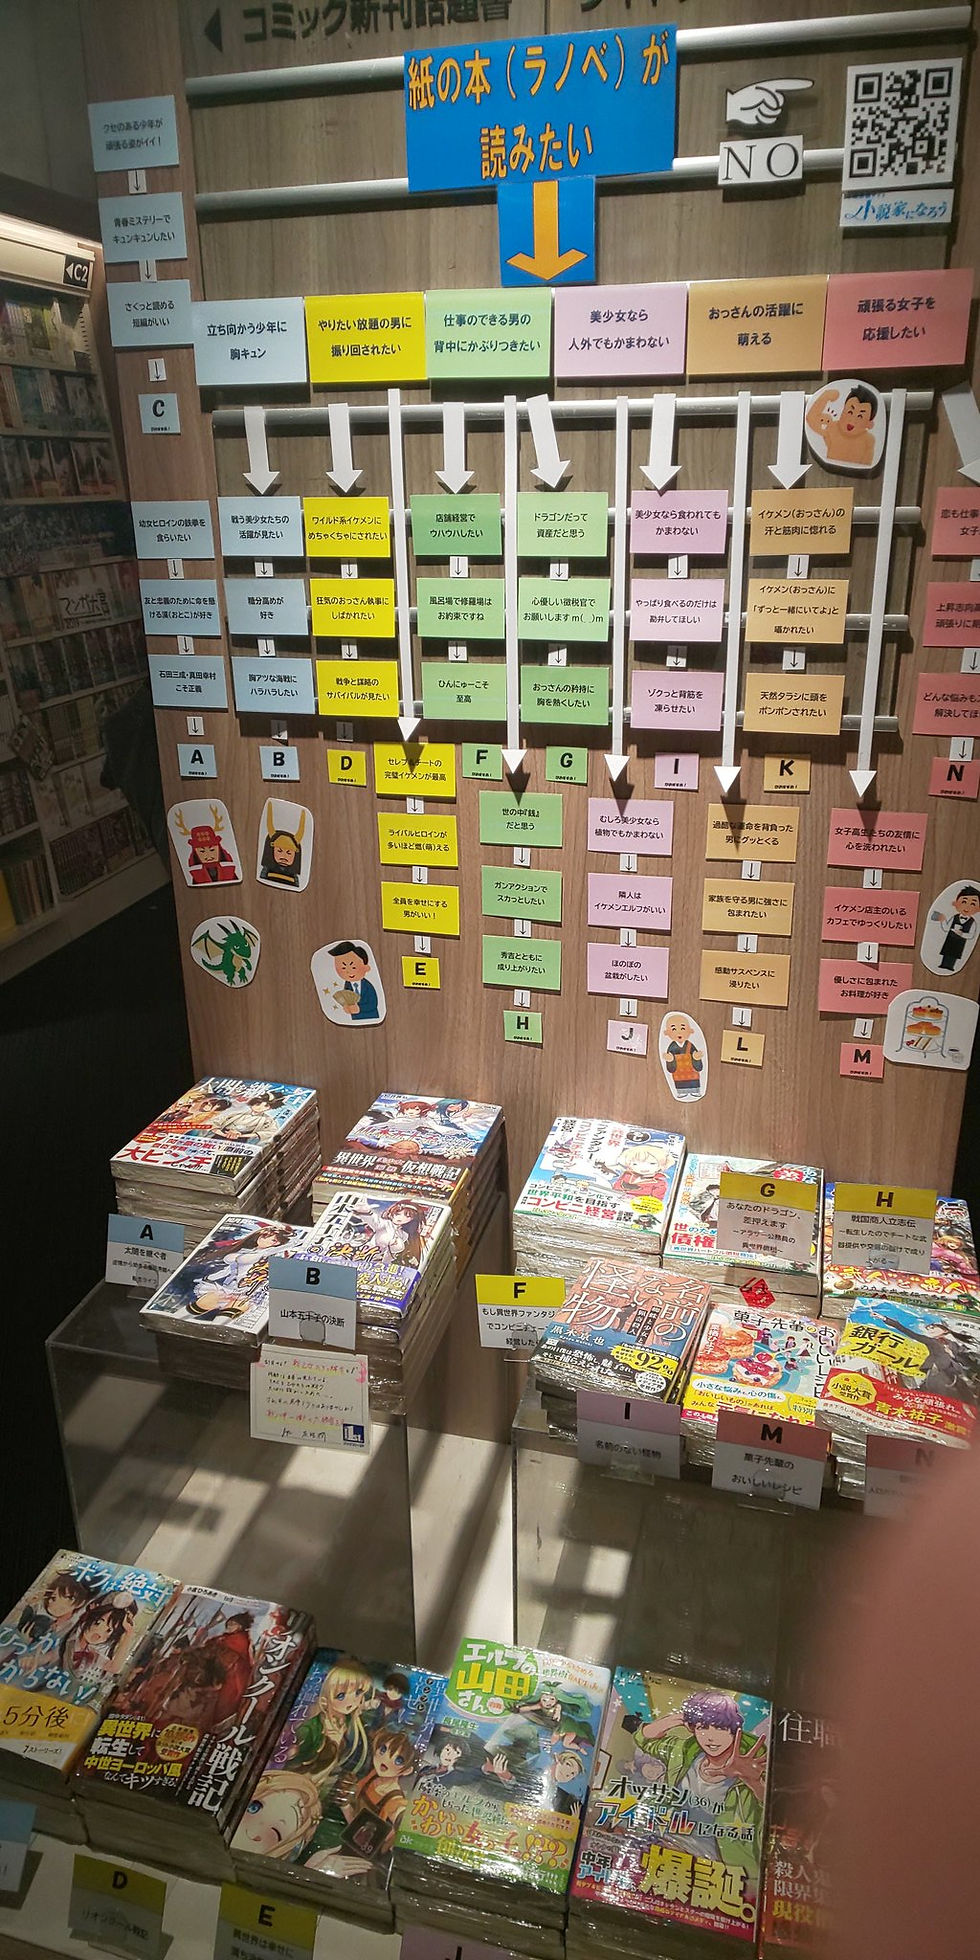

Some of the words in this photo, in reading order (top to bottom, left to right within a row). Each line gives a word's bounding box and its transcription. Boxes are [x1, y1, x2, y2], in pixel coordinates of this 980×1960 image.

[480, 123, 594, 180] 読みたい
[723, 143, 799, 181] NO
[844, 199, 947, 221] 小説家になろう
[114, 215, 171, 227] 青春ミステリーで
[113, 234, 175, 244] キュンキュンしたい
[73, 263, 89, 280] C2
[125, 301, 175, 312] さくっと読める
[709, 302, 803, 320] おっさんの活躍に
[857, 296, 935, 313] 頑張る女子を
[443, 312, 530, 327] 仕事のできる男の
[589, 309, 649, 323] 美少女なら
[207, 320, 287, 337] 立ち向かう少年に
[318, 316, 411, 333] やりたい放題の男に
[737, 331, 772, 345] 萌える
[863, 325, 925, 341] 応援したい
[331, 342, 401, 357] 振り回されたい
[434, 338, 541, 354] 背中にかぶりつきたい
[568, 335, 669, 351] 人外でもかまわない
[230, 346, 266, 360] 胸キュン
[152, 400, 165, 417] C
[231, 515, 289, 524] 戦う美少女たちの
[312, 516, 381, 525] ワイルド系イケメンに
[436, 513, 475, 522] 店舗経営で
[534, 512, 588, 522] ドラゴンだって
[635, 510, 721, 520] 美少女なら食われても
[239, 530, 283, 539] 活躍が見たい
[308, 531, 388, 540] めちゃくちゃにされたい
[430, 528, 483, 538] ウハウハしたい
[536, 528, 584, 538] 資産だと思う
[656, 526, 698, 535] かまわない
[764, 525, 836, 535] 汗と筋肉に惚れる
[157, 533, 191, 542] 食らいたい
[317, 596, 389, 606] 狂気のおっさん執事に
[430, 596, 492, 606] 風呂場で修羅場は
[636, 599, 717, 609] やっぱり食べるのだけは
[260, 611, 274, 619] 好き
[332, 611, 374, 620] しばかれたい
[438, 612, 484, 621] お約束ですね
[650, 615, 700, 624] 勘弁してほしい
[249, 674, 297, 683] 胸アツな海戦に
[336, 678, 378, 686] 戦争と謀略の
[438, 680, 488, 689] ひんにゅーこそ
[176, 684, 202, 693] こそ正義
[251, 688, 298, 697] ハラハラしたい
[532, 683, 594, 693] おっさんの矜持に
[648, 689, 703, 699] ゾクっと背筋を
[326, 691, 390, 701] サバイバルが見たい
[456, 694, 472, 703] 至高
[760, 691, 827, 702] 天然タラシに頭を
[537, 698, 590, 708] 胸を熱くしたい
[655, 704, 696, 713] 凍らせたい
[191, 750, 203, 764] A
[273, 752, 284, 766] B
[341, 756, 352, 770] D
[476, 750, 488, 764] F
[560, 753, 573, 768] G
[674, 759, 679, 774] I
[779, 760, 794, 776] K
[947, 764, 964, 781] N
[384, 771, 446, 781] 完璧イケメンが最高
[506, 821, 535, 831] だと思う
[600, 815, 660, 826] むしろ美少女なら
[388, 828, 447, 839] ライバルヒロインが
[595, 828, 664, 839] 植物でもかまわない
[834, 827, 920, 839] 女子高生たちの友情に
[725, 835, 779, 846] 男にグッとくる
[845, 841, 905, 853] 心を洗われたい
[494, 881, 548, 892] ガンアクションで
[497, 894, 545, 906] スカっとしたい
[618, 890, 641, 899] 隣人は
[708, 894, 787, 907] 家族を守る男に強さに
[393, 897, 448, 908] 全員を幸せにする
[594, 903, 665, 914] イケメンエルフがいい
[727, 909, 767, 918] 包まれたい
[834, 904, 906, 915] イケメン店主のいる
[827, 917, 912, 930] カフェでゆっくりしたい
[501, 951, 542, 962] 秀吉とともに
[416, 962, 426, 976] E
[497, 964, 545, 974] 成り上がりたい
[715, 966, 775, 977] 感動サスペンスに
[605, 971, 648, 982] 盆栽がしたい
[833, 975, 897, 986] 優しさに包まれた
[729, 980, 759, 989] 浸りたい
[840, 989, 889, 999] お料理が好き
[517, 1016, 528, 1030] H
[622, 1028, 633, 1040] J
[737, 1037, 748, 1051] L
[854, 1049, 870, 1065] M
[760, 1183, 775, 1197] G
[527, 1190, 620, 1208] 世界平和を目指す
[876, 1191, 894, 1208] H
[743, 1216, 788, 1229] 差押えます
[851, 1215, 916, 1228] 戦国商人立志伝
[140, 1224, 153, 1240] A
[306, 1267, 320, 1285] B
[513, 1282, 527, 1298] F
[562, 1257, 637, 1331] 怪物
[633, 1271, 671, 1308] ない
[654, 1278, 704, 1341] 名前の
[280, 1310, 345, 1328] 山本五十子の決断
[849, 1326, 905, 1349] 銀行
[851, 1341, 919, 1370] ガール
[832, 1382, 873, 1400] 小説大賞
[624, 1403, 630, 1420] I
[875, 1401, 944, 1425] 青木祐子
[761, 1423, 782, 1443] M
[743, 1453, 794, 1470] 菓子先輩の
[731, 1473, 802, 1495] おいしいレシピ
[73, 1563, 171, 1606] ボクは絶対
[463, 1644, 537, 1675] エルフの
[456, 1663, 531, 1699] 山田
[458, 1689, 487, 1715] さん
[3, 1705, 69, 1729] 5分後
[90, 1737, 145, 1757] 転生して
[84, 1756, 183, 1777] 中世ヨーロッパ風
[698, 1823, 755, 1842] になる話
[112, 1871, 127, 1889] D
[258, 1904, 276, 1927] E
